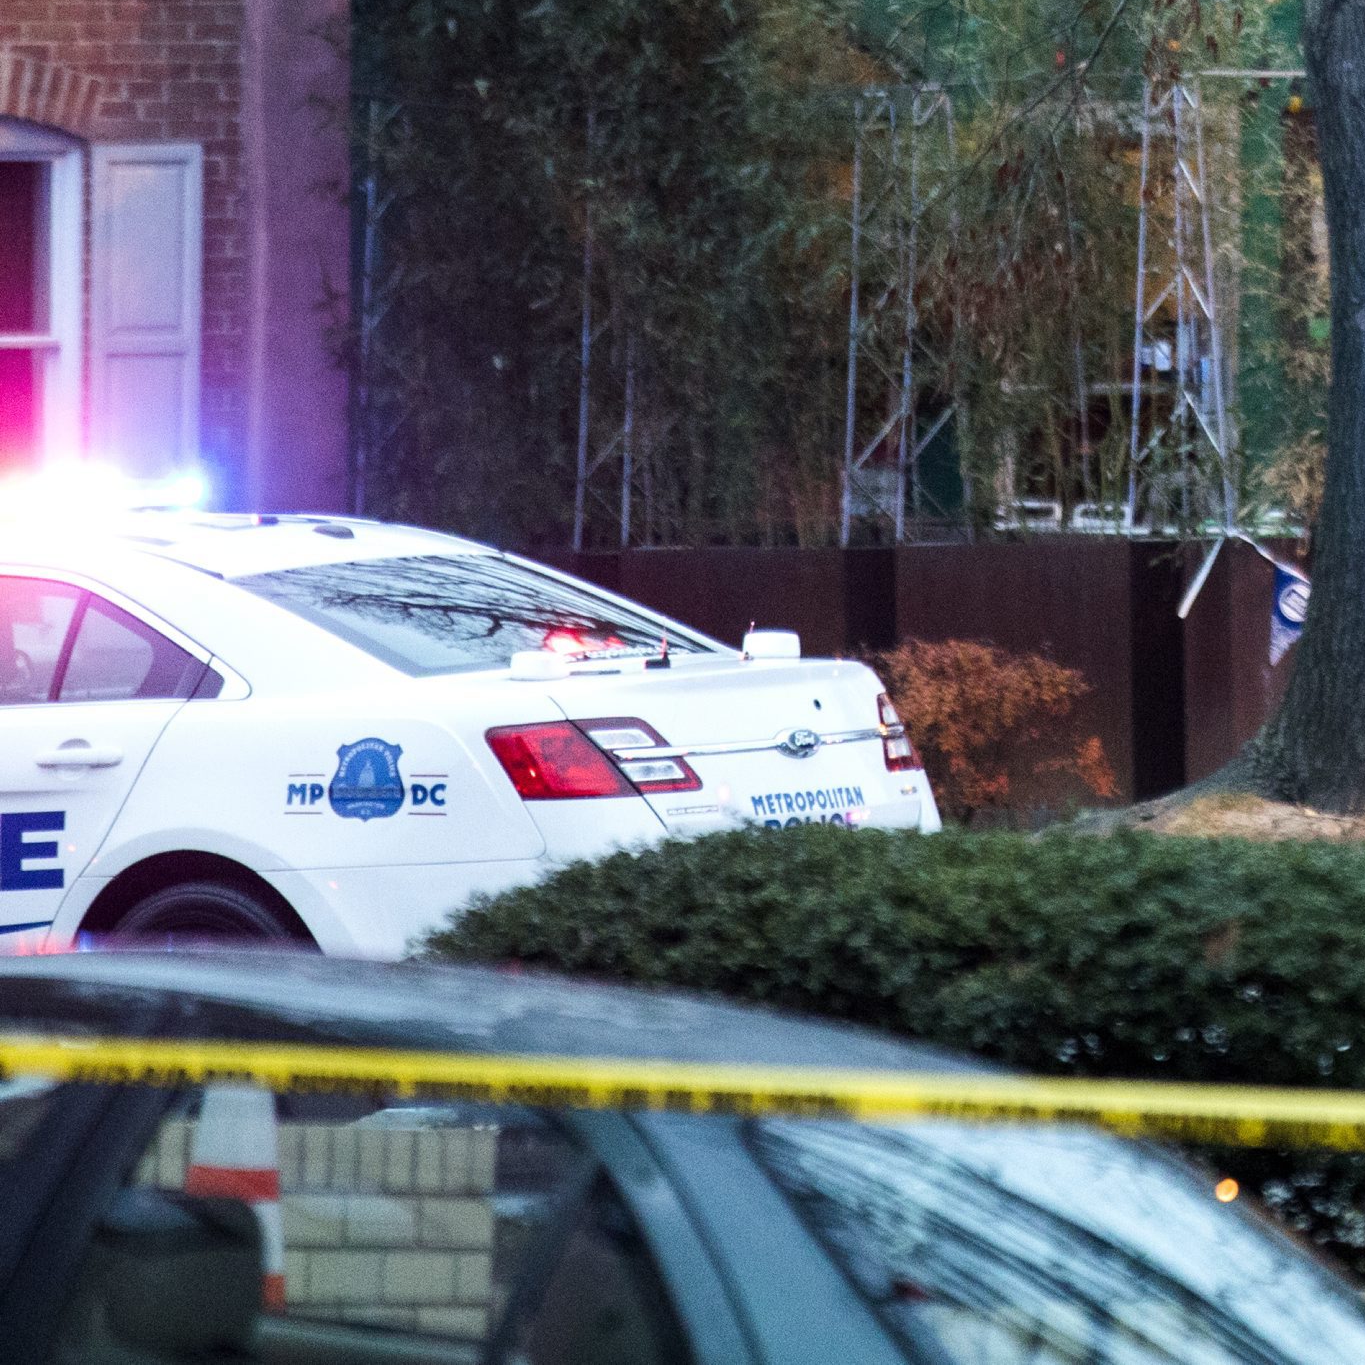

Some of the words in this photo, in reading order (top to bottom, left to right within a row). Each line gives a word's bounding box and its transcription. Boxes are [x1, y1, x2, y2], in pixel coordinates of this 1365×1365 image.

[286, 783, 324, 806] MP
[411, 783, 447, 806] DC
[751, 786, 865, 815] METROPOLITAN
